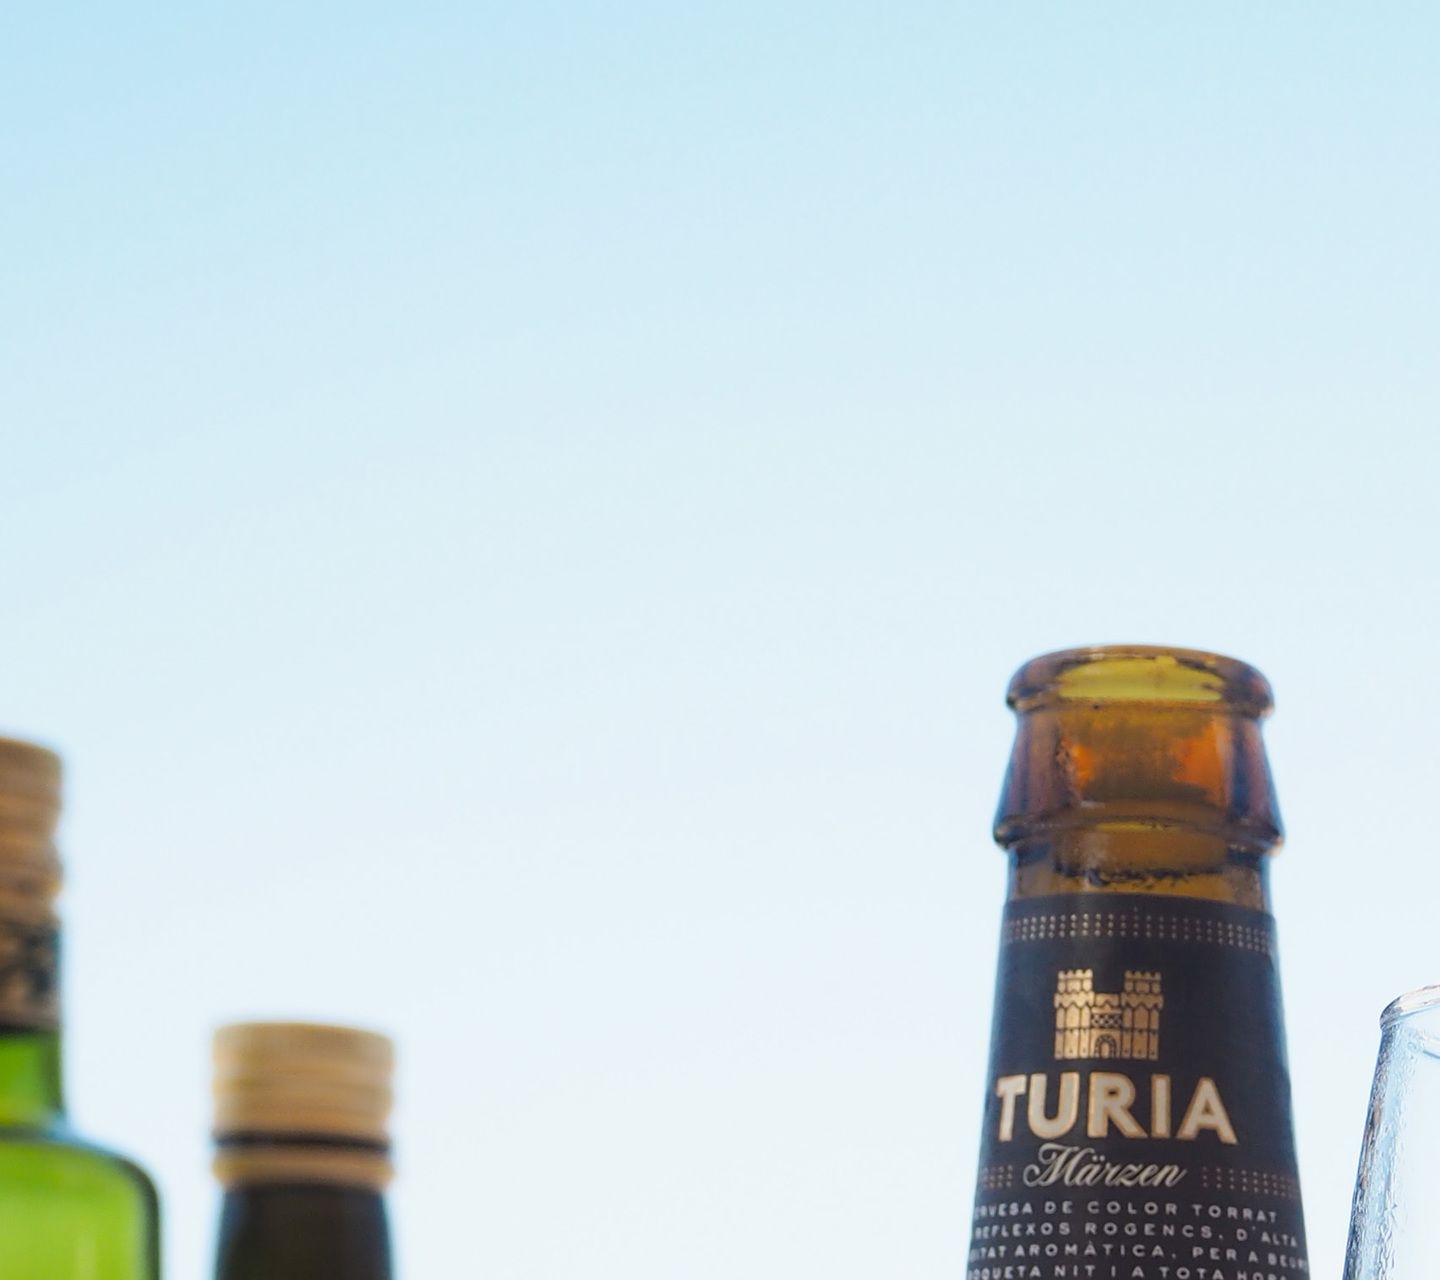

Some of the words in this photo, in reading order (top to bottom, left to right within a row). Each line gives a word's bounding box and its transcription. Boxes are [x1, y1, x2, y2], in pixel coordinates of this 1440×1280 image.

[996, 1071, 1239, 1145] TURIA
[1022, 1143, 1188, 1188] Märzen
[1044, 1201, 1073, 1215] DE
[1087, 1201, 1178, 1216] COLOR
[1192, 1204, 1277, 1223] TORRAT
[1192, 1246, 1238, 1262] PER
[1248, 1251, 1260, 1264] A
[1054, 1264, 1096, 1278] NIT
[1110, 1265, 1117, 1278] I
[1131, 1265, 1146, 1279] A
